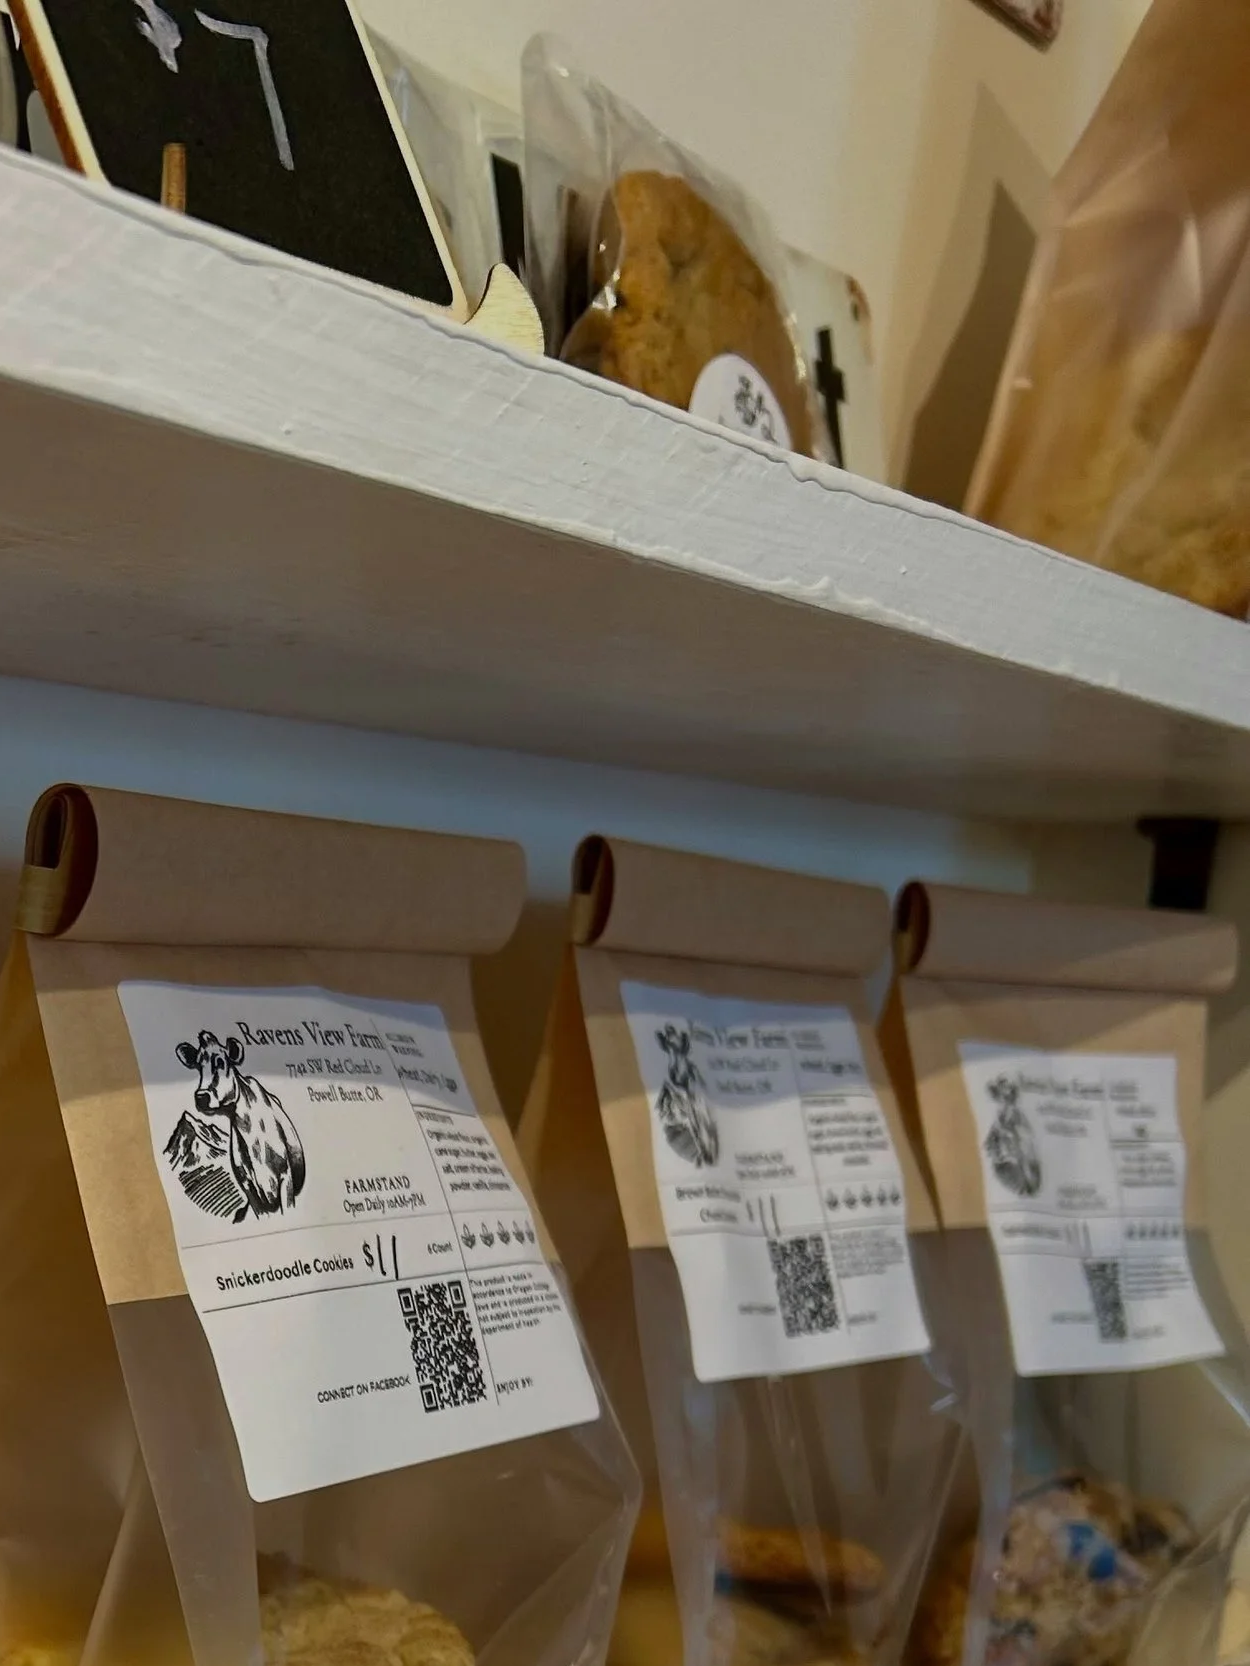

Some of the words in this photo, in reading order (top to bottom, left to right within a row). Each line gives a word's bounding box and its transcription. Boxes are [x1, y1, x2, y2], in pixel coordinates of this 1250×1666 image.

[236, 1021, 304, 1047] Ravens
[301, 1021, 345, 1047] View
[344, 1023, 386, 1050] Farm
[306, 1059, 325, 1073] SW
[325, 1058, 344, 1074] Red
[306, 1084, 338, 1103] Powell
[366, 1084, 384, 1102] OR
[344, 1174, 412, 1194] FARMSTAND
[342, 1198, 365, 1217] Open
[364, 1196, 386, 1214] Daily
[216, 1258, 312, 1292] Snickerdoodle
[312, 1254, 354, 1275] Cookies
[316, 1384, 355, 1404] CONNECT
[356, 1383, 369, 1397] ON
[369, 1374, 412, 1393] FACEBOOK
[496, 1379, 520, 1395] ENJOY
